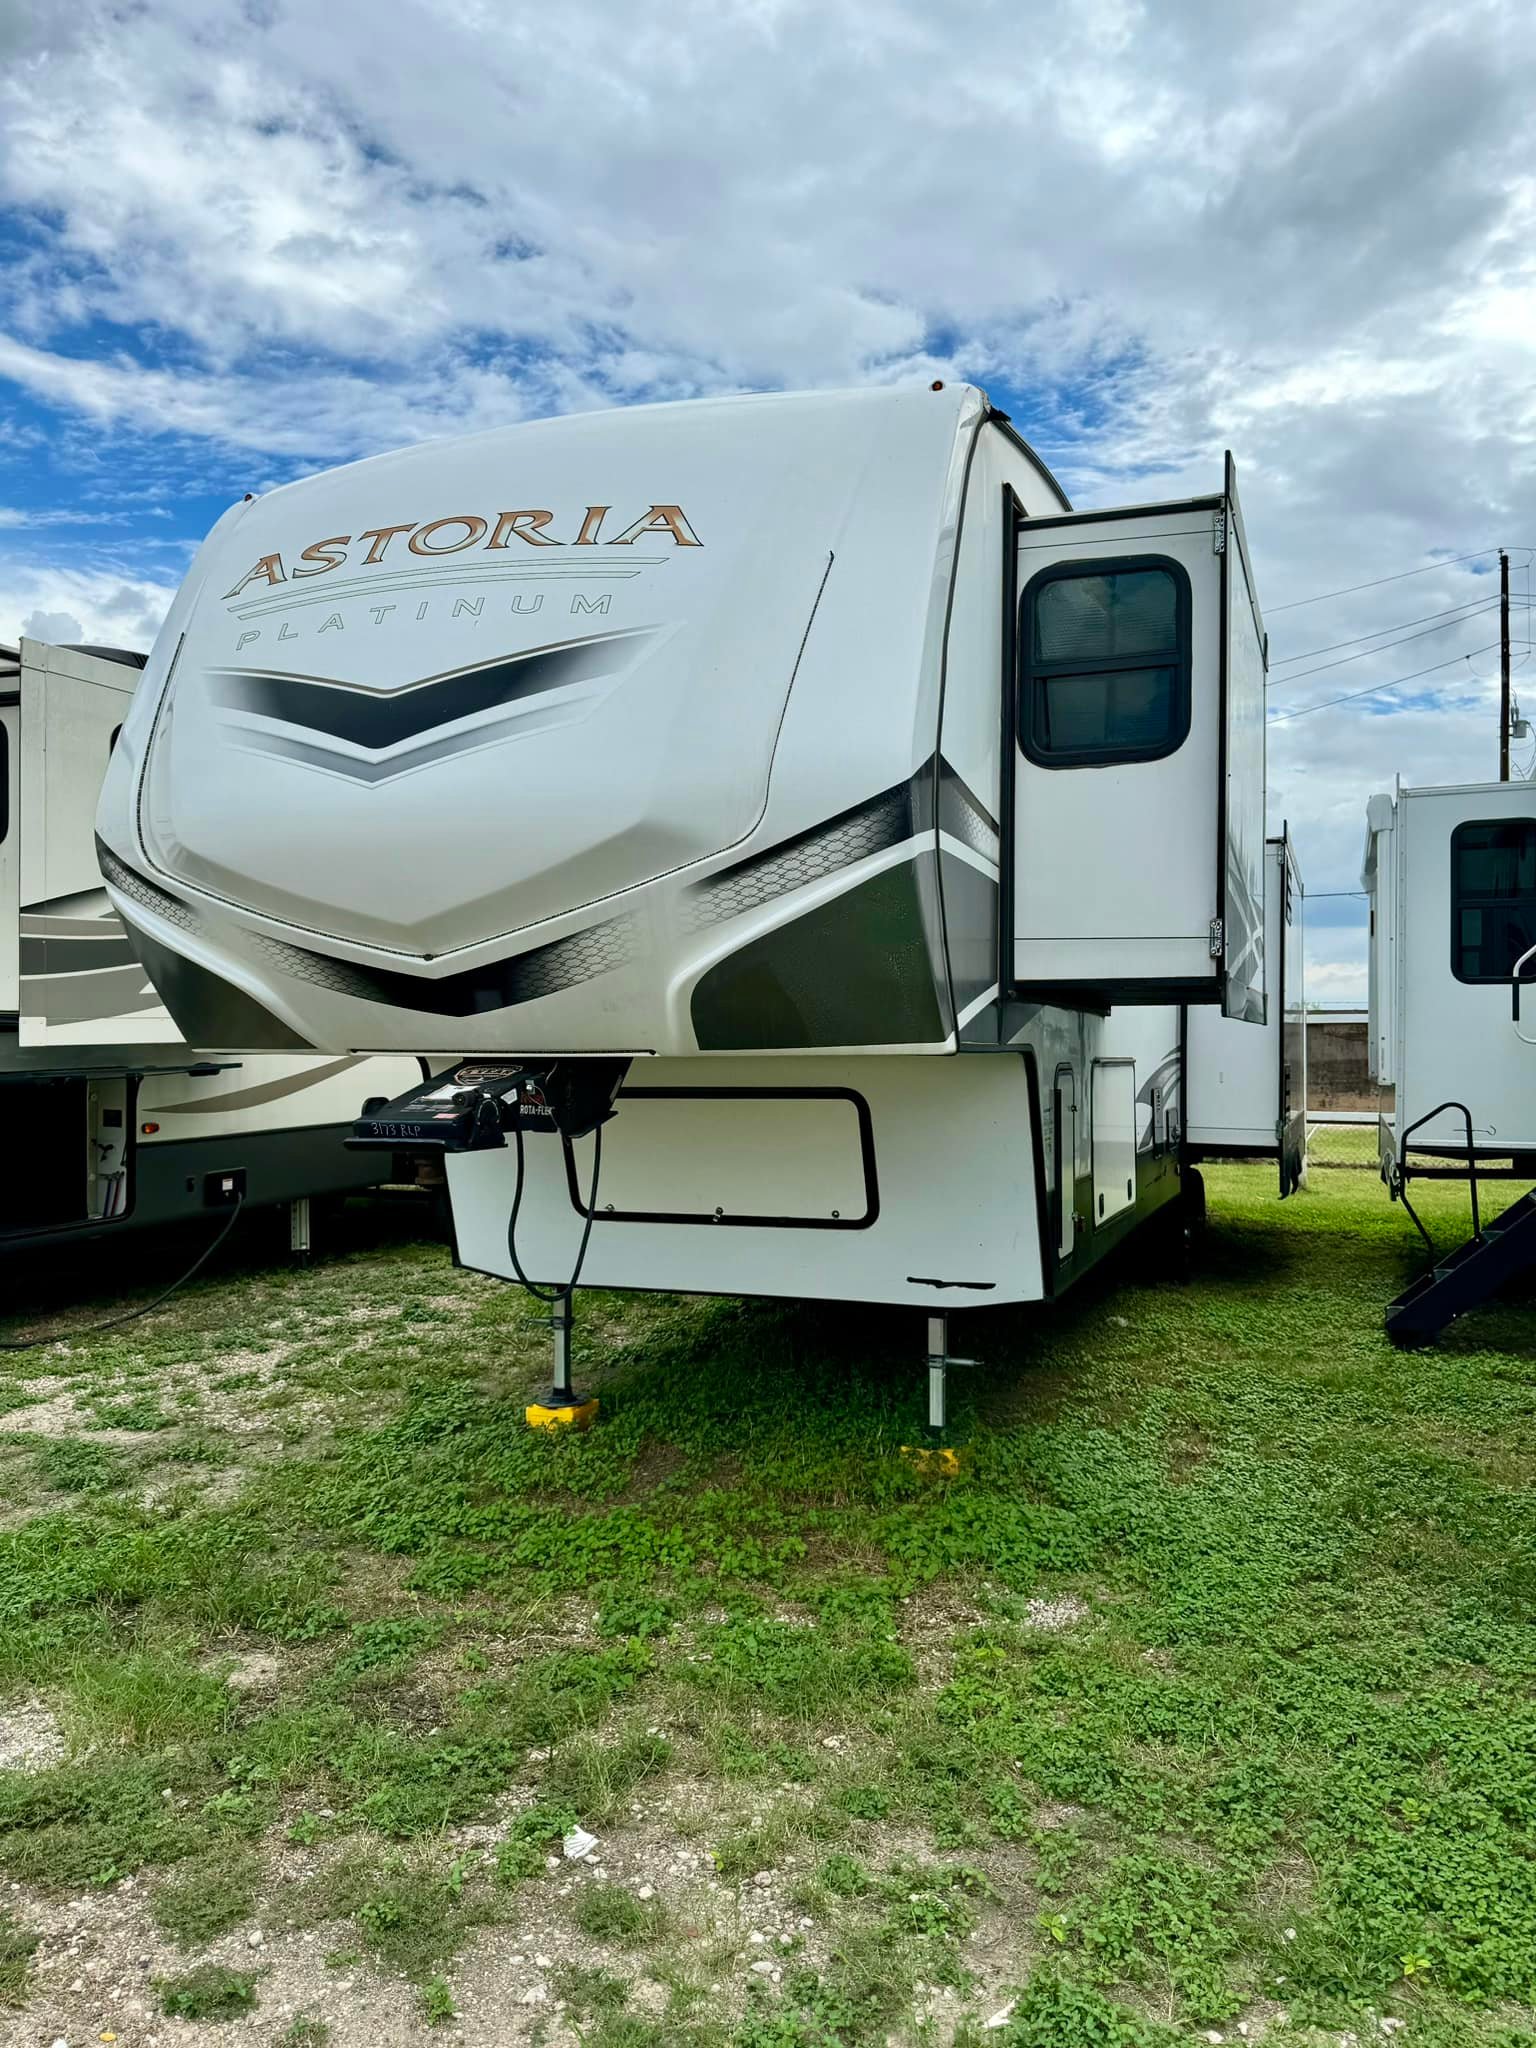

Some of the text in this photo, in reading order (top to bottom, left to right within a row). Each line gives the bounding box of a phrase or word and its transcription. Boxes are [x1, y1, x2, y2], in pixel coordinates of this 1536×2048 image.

[221, 505, 704, 600] ASTORIA
[236, 594, 612, 651] PLATINUM
[371, 1122, 421, 1137] 3173 RLP
